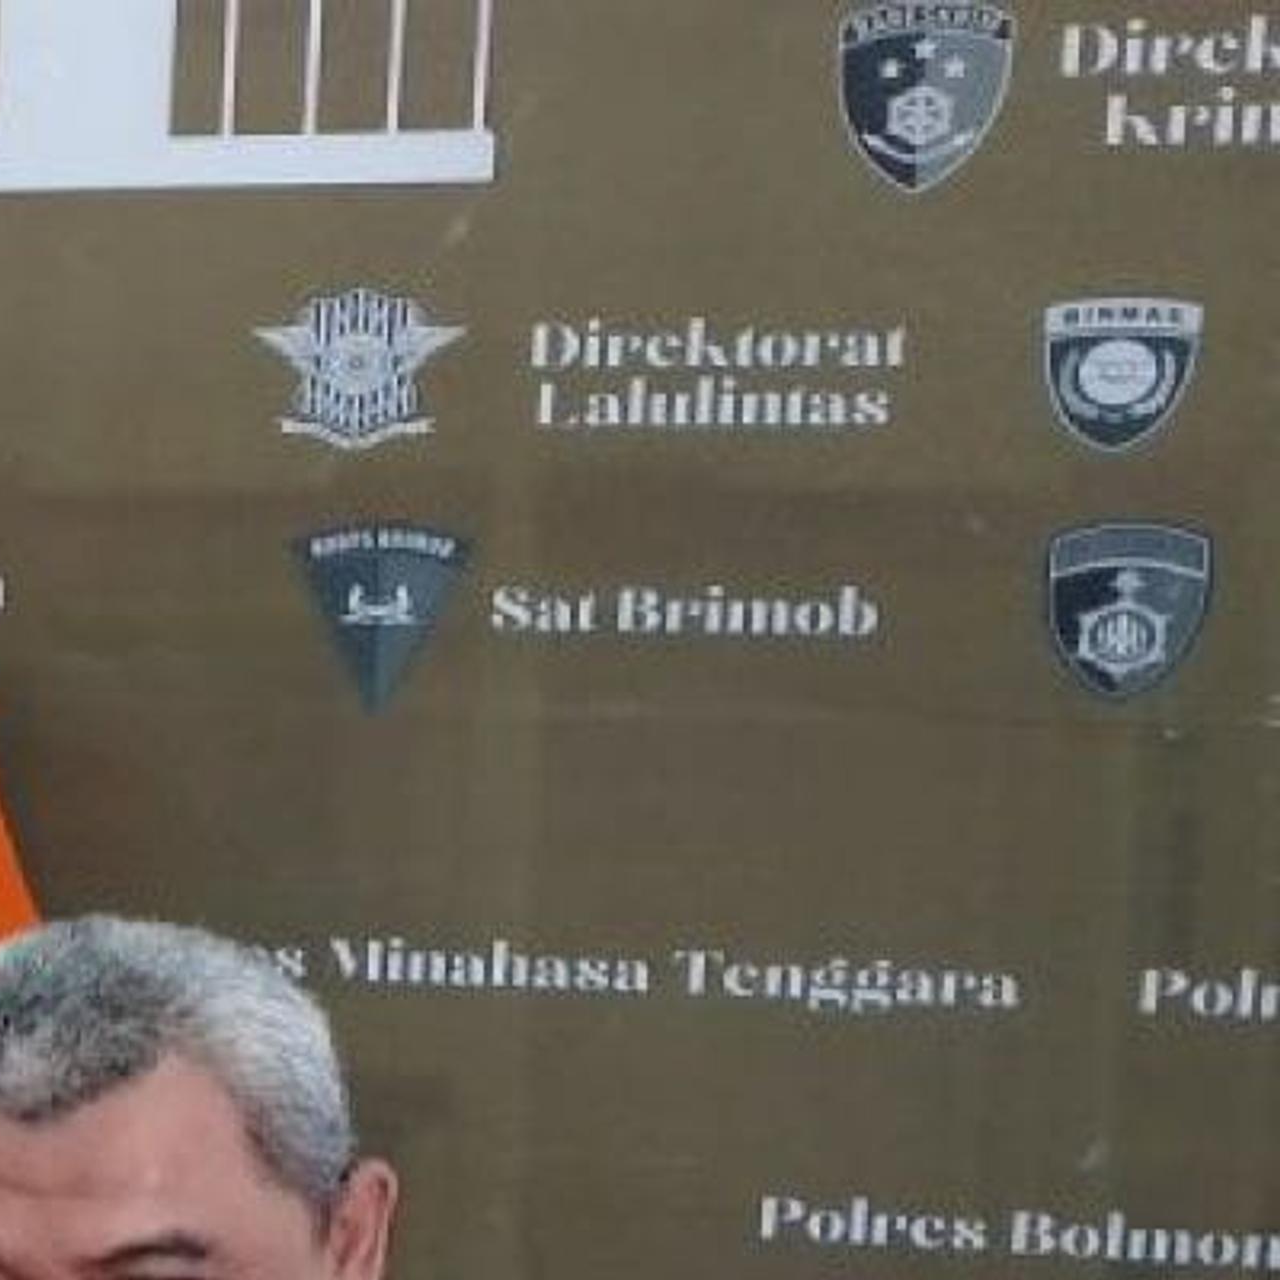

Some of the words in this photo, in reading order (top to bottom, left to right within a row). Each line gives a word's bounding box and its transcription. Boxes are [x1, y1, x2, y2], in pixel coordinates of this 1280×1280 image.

[531, 318, 905, 368] Direktorat
[491, 588, 595, 633] Sat
[617, 586, 878, 637] Brimob
[330, 938, 649, 993] Minahasa
[674, 950, 1019, 1011] Tenggara
[760, 1196, 986, 1250] Polres
[1010, 1210, 1280, 1270] Bolmon
